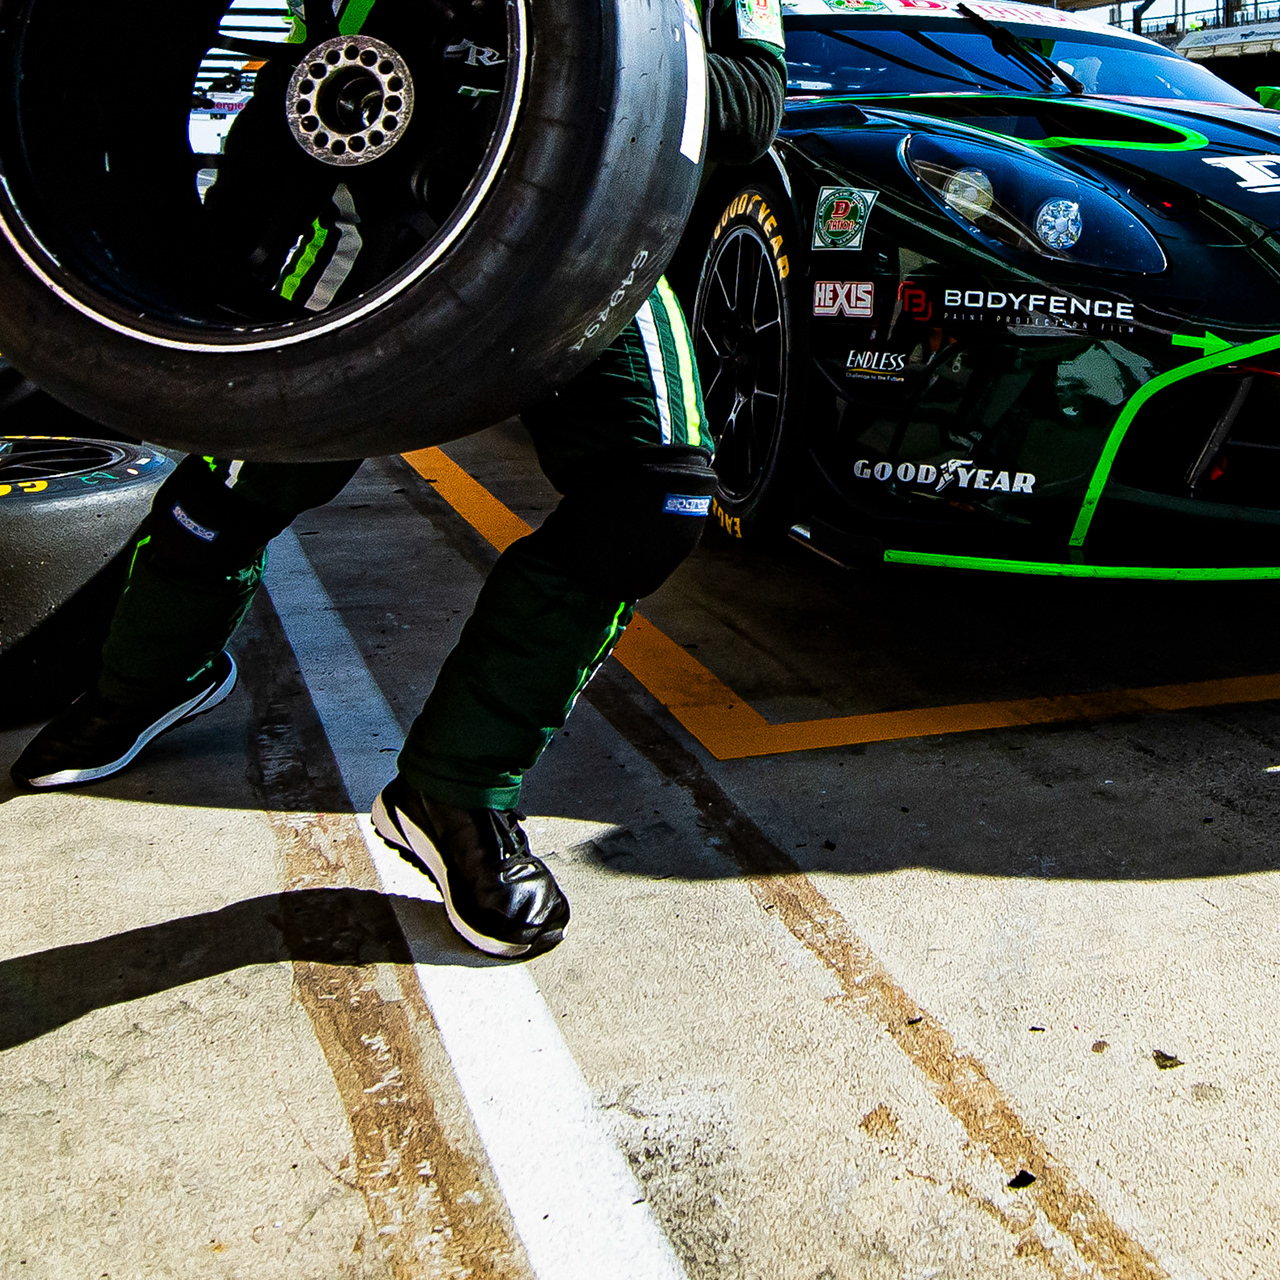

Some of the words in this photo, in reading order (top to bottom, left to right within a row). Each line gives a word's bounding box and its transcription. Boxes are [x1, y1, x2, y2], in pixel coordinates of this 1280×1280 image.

[814, 283, 873, 315] HEXIS
[944, 289, 1135, 320] BODYFENCE
[1102, 323, 1134, 333] FILM
[846, 350, 907, 371] ENDLESS
[854, 459, 1037, 494] GOODYEAR
